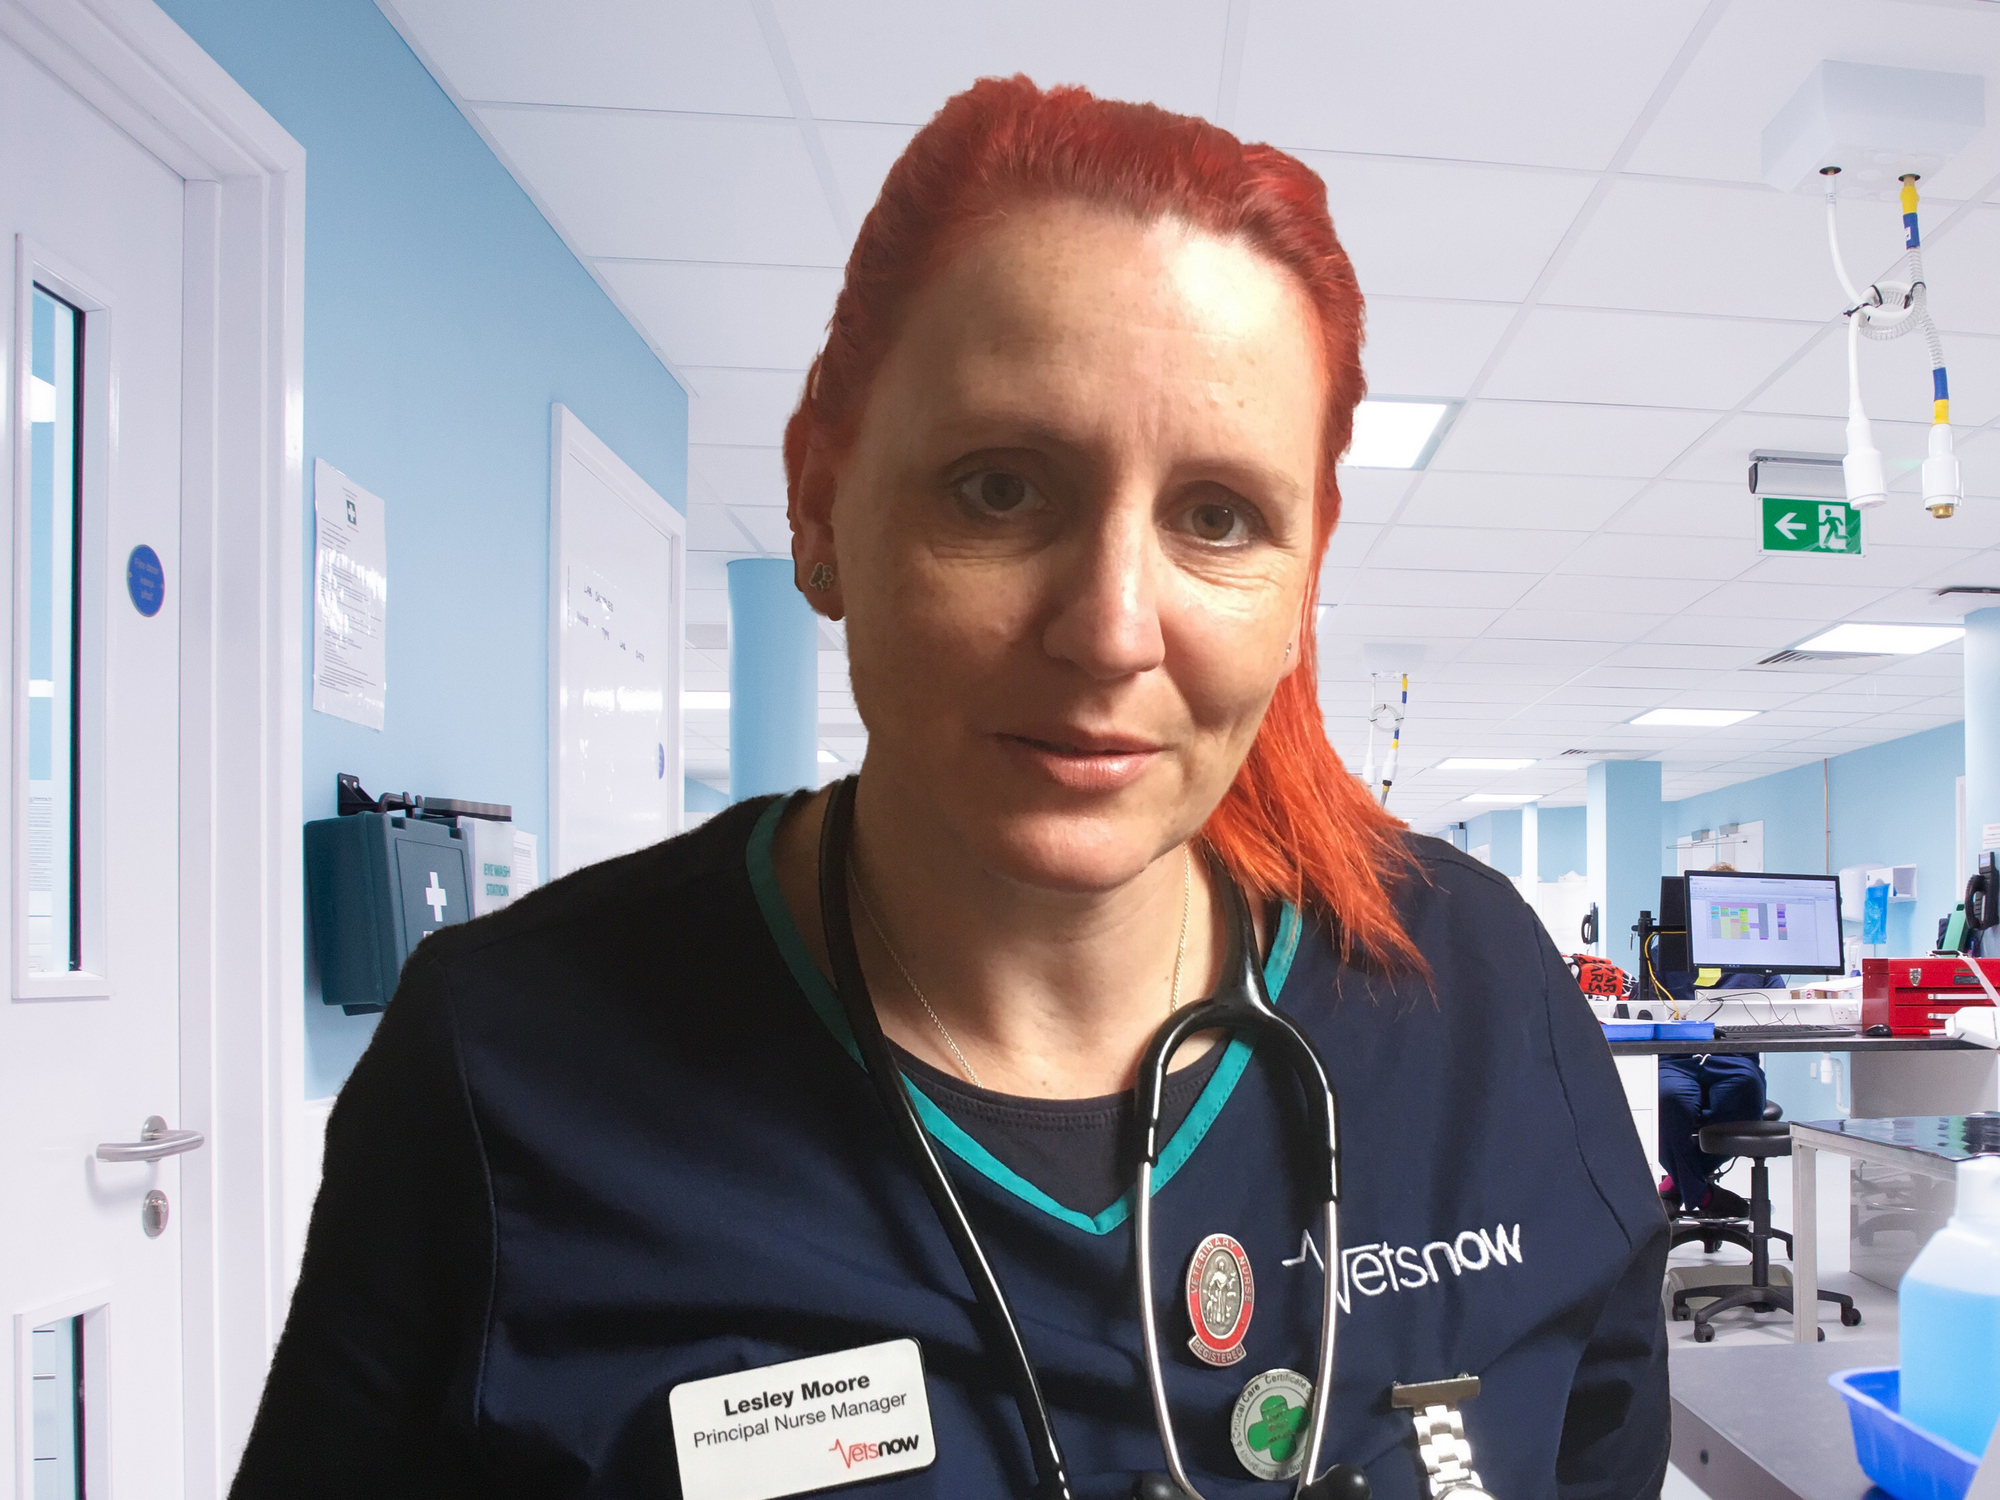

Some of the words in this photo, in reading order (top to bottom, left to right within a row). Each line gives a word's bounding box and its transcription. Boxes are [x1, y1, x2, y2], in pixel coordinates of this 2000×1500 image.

[486, 883, 509, 896] STATION
[1190, 1237, 1238, 1294] VETERINARY
[1238, 1254, 1252, 1303] NURSE
[1192, 1339, 1243, 1364] REGISTERED
[1241, 1383, 1261, 1403] Care
[1264, 1373, 1307, 1389] Certificate
[723, 1389, 795, 1416] Lesley
[800, 1374, 871, 1401] Moore
[693, 1418, 770, 1448] Principal
[774, 1410, 827, 1431] Nurse
[831, 1391, 908, 1420] Manager
